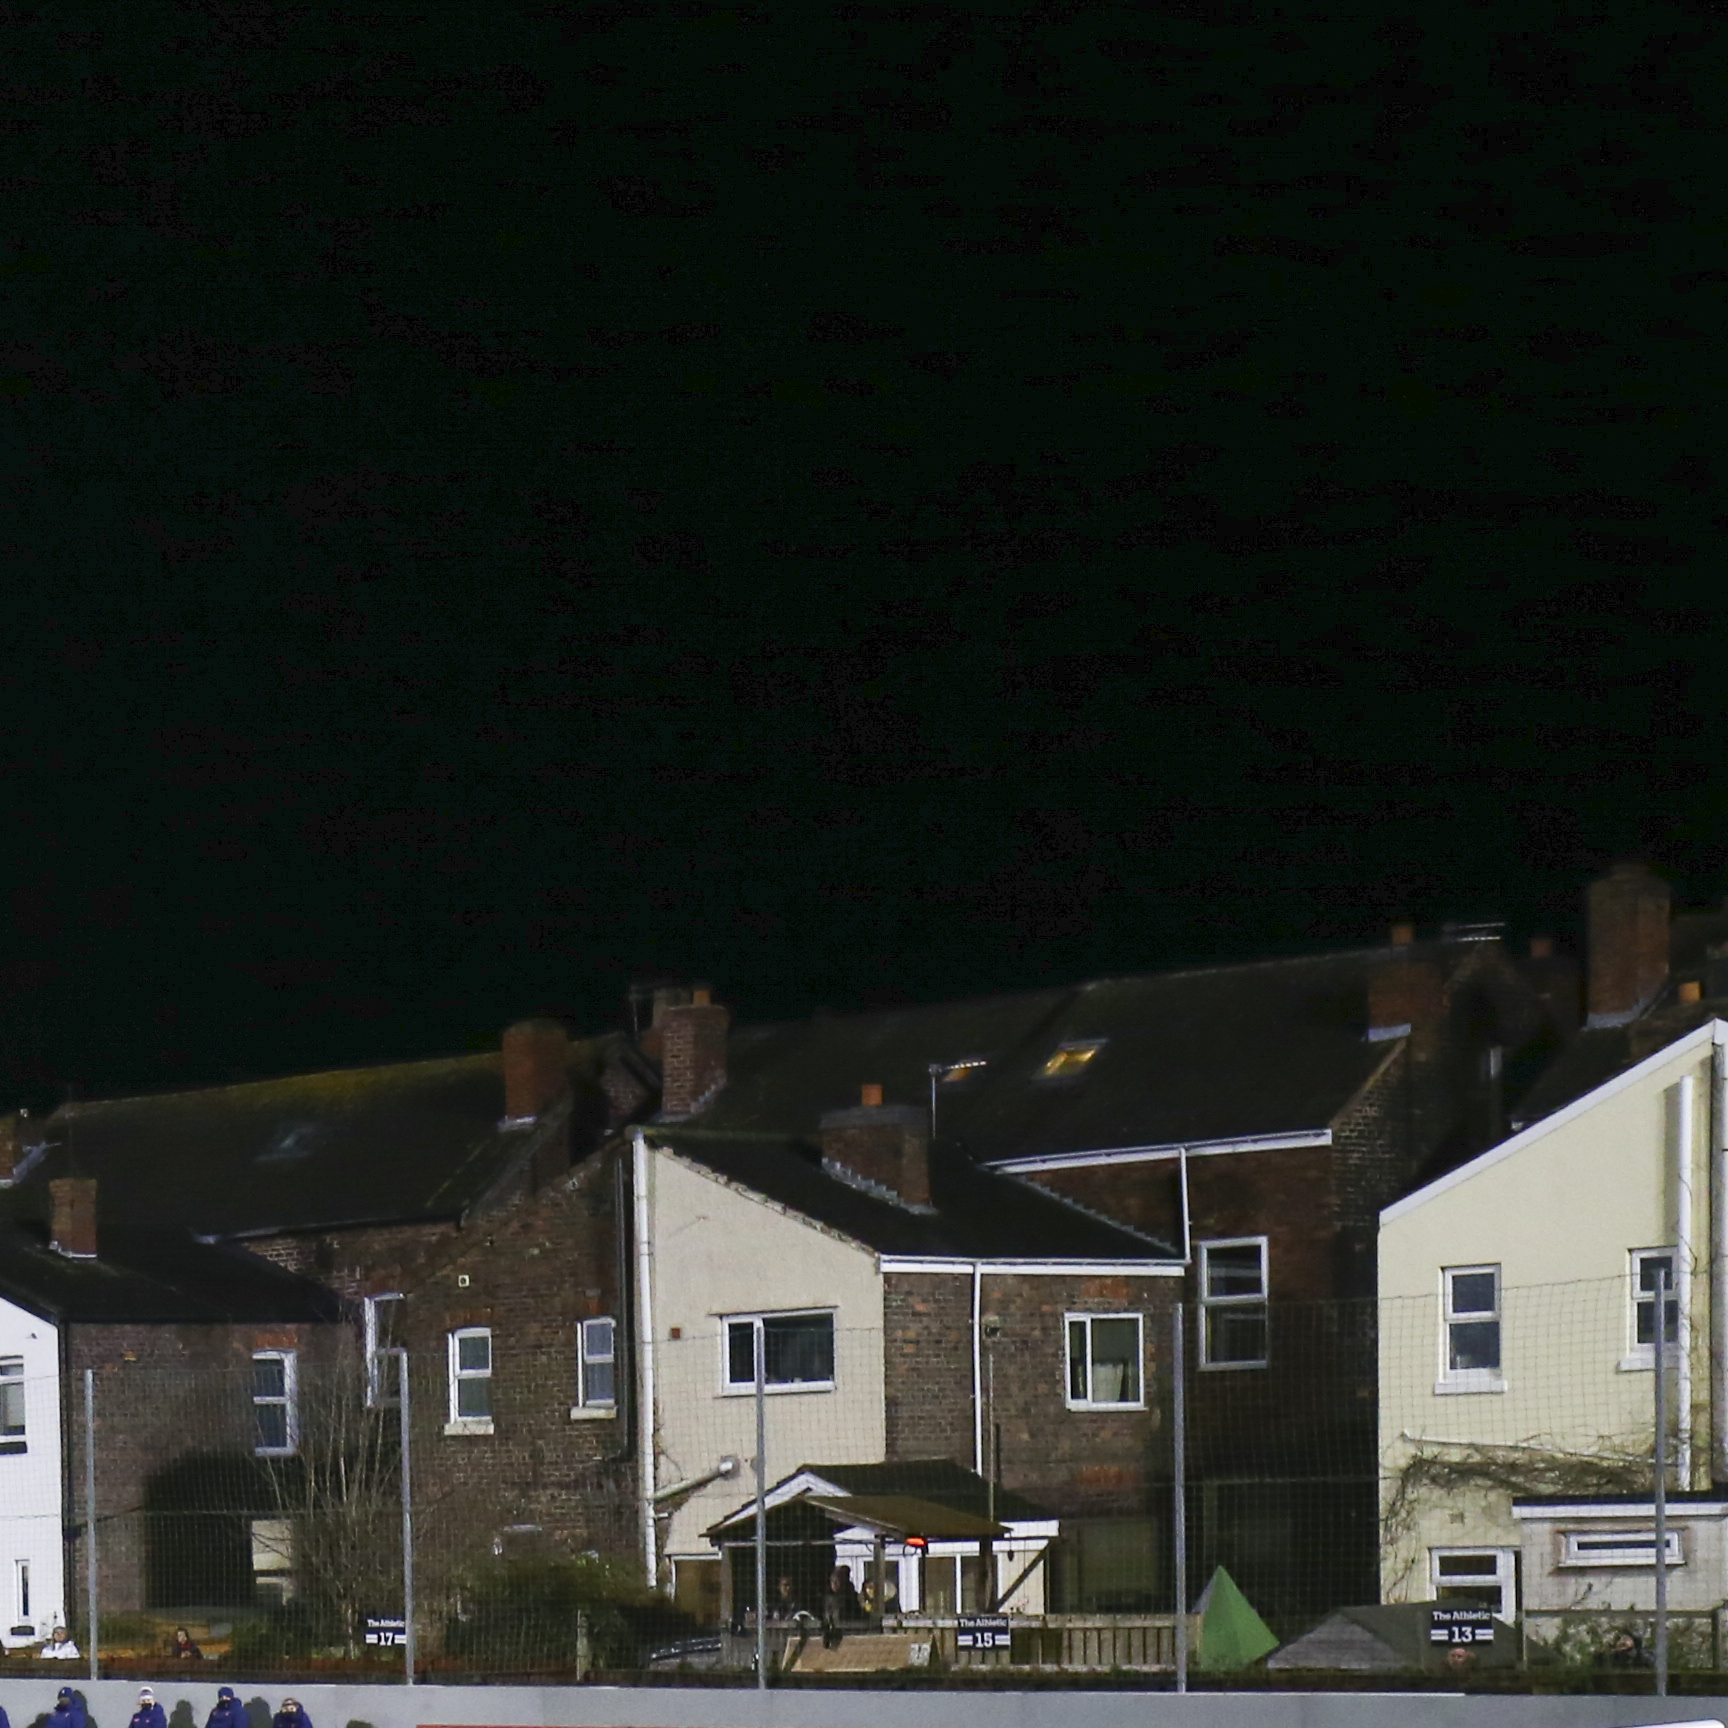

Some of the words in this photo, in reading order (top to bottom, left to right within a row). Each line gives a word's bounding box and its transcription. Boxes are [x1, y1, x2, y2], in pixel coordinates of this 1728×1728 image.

[1432, 1611, 1451, 1620] The
[1452, 1610, 1491, 1620] Athletic
[379, 1631, 394, 1646] 17
[975, 1632, 993, 1648] 15
[1451, 1626, 1473, 1643] 13
